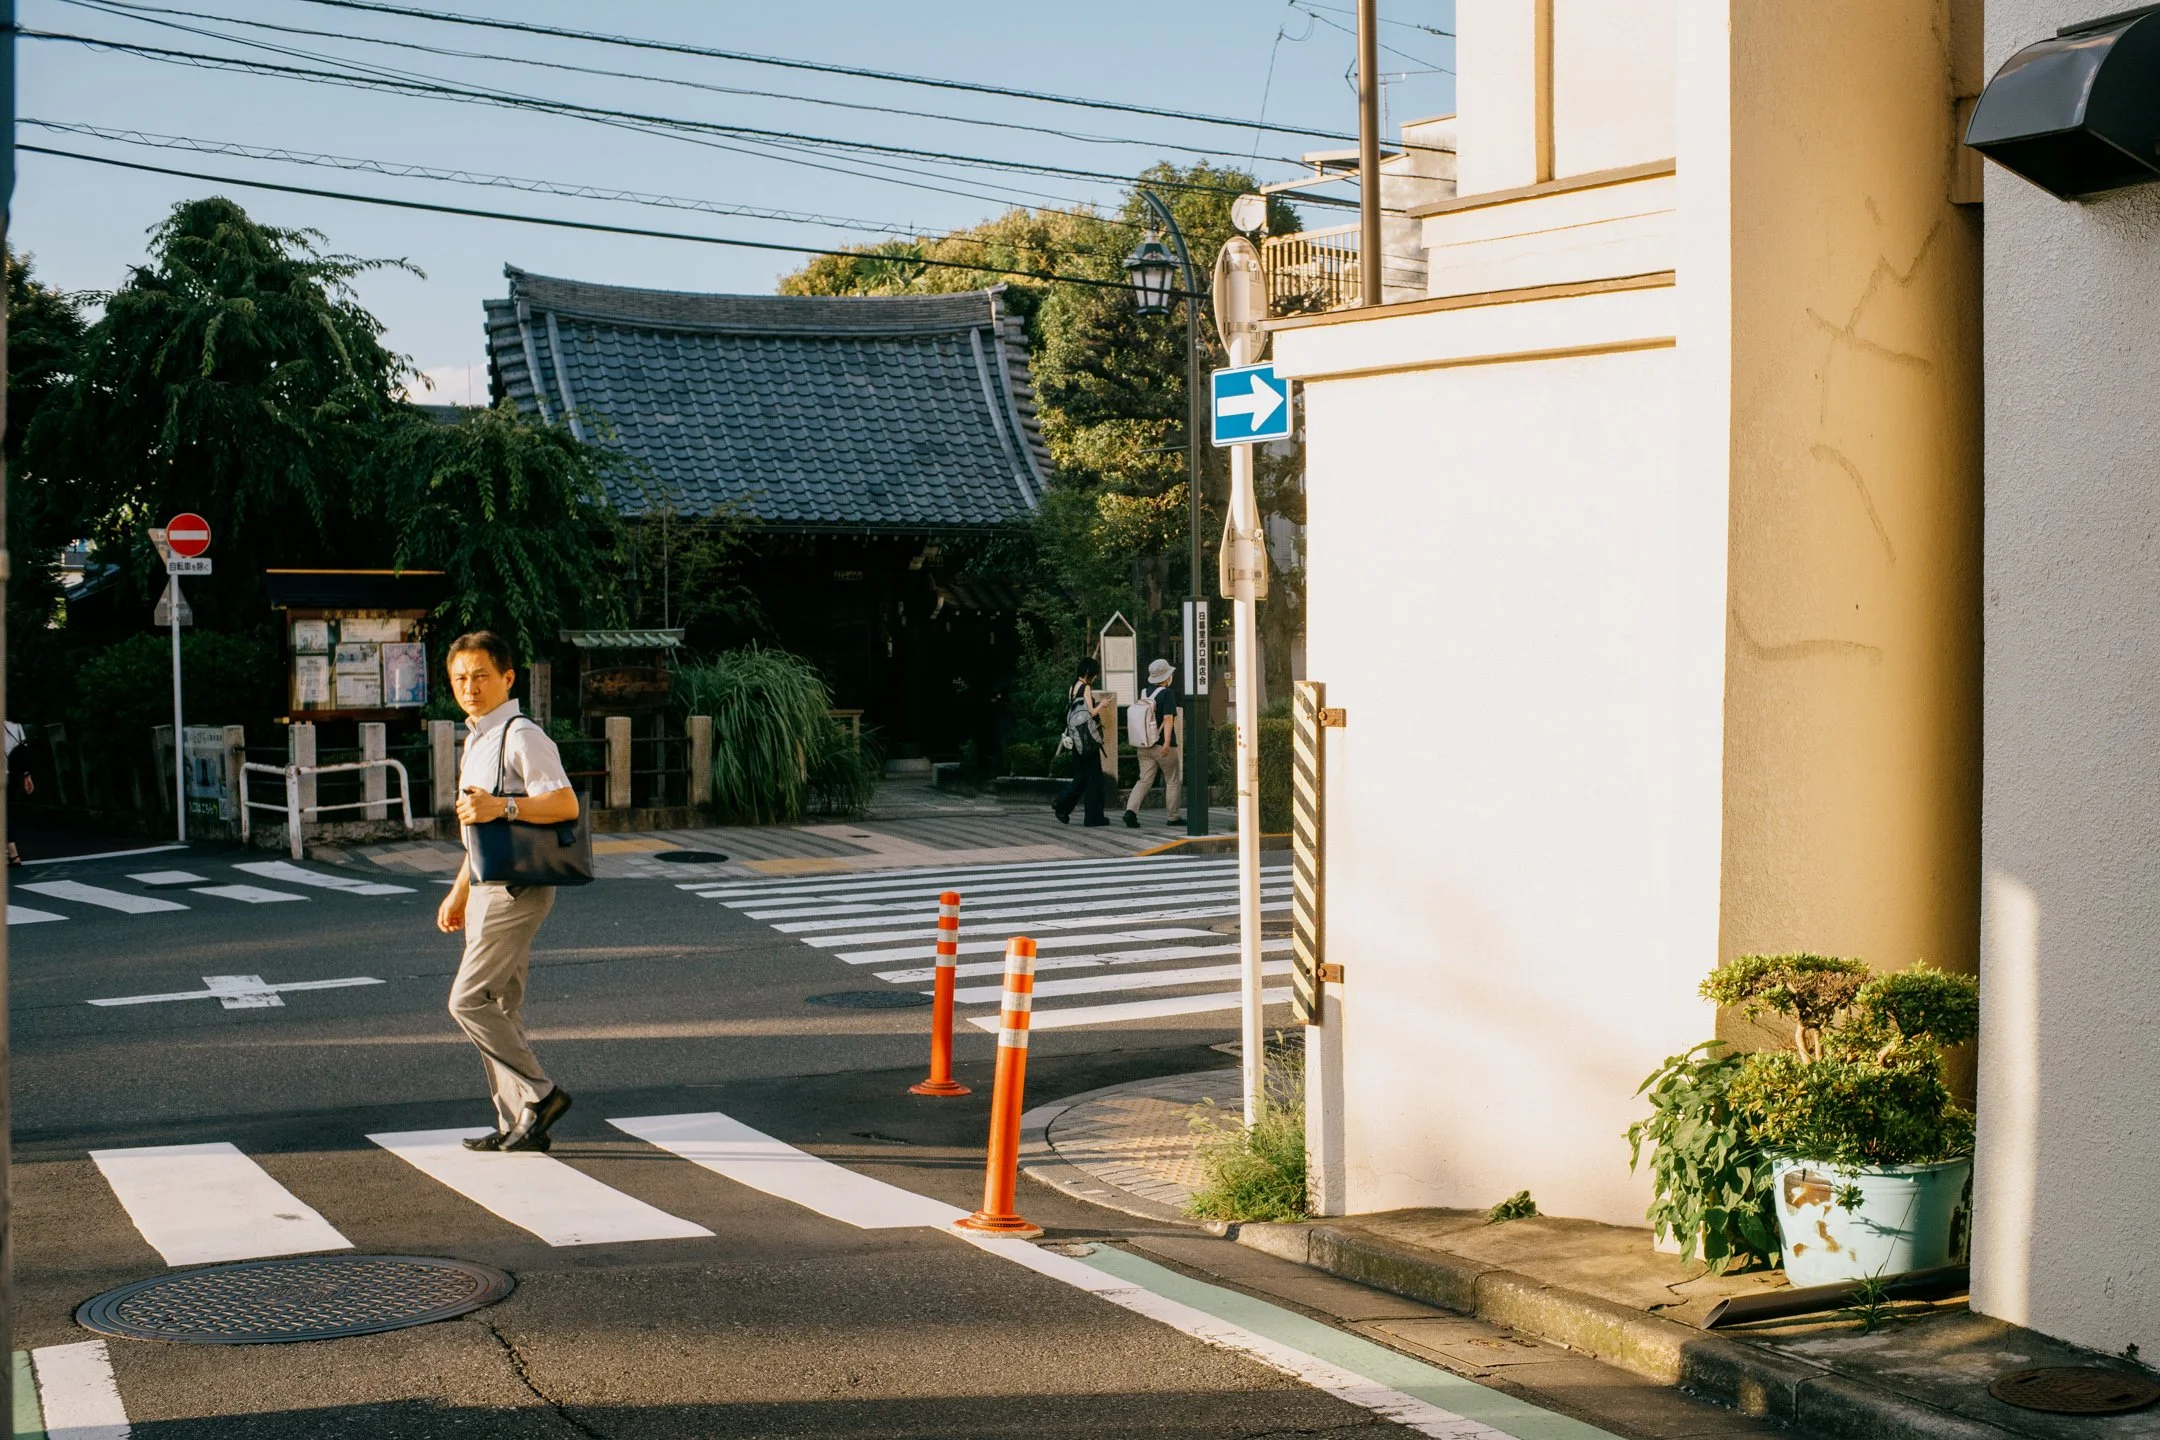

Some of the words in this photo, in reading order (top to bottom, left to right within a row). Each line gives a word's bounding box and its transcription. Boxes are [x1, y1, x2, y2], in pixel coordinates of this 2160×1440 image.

[169, 561, 209, 571] 自転車を除く
